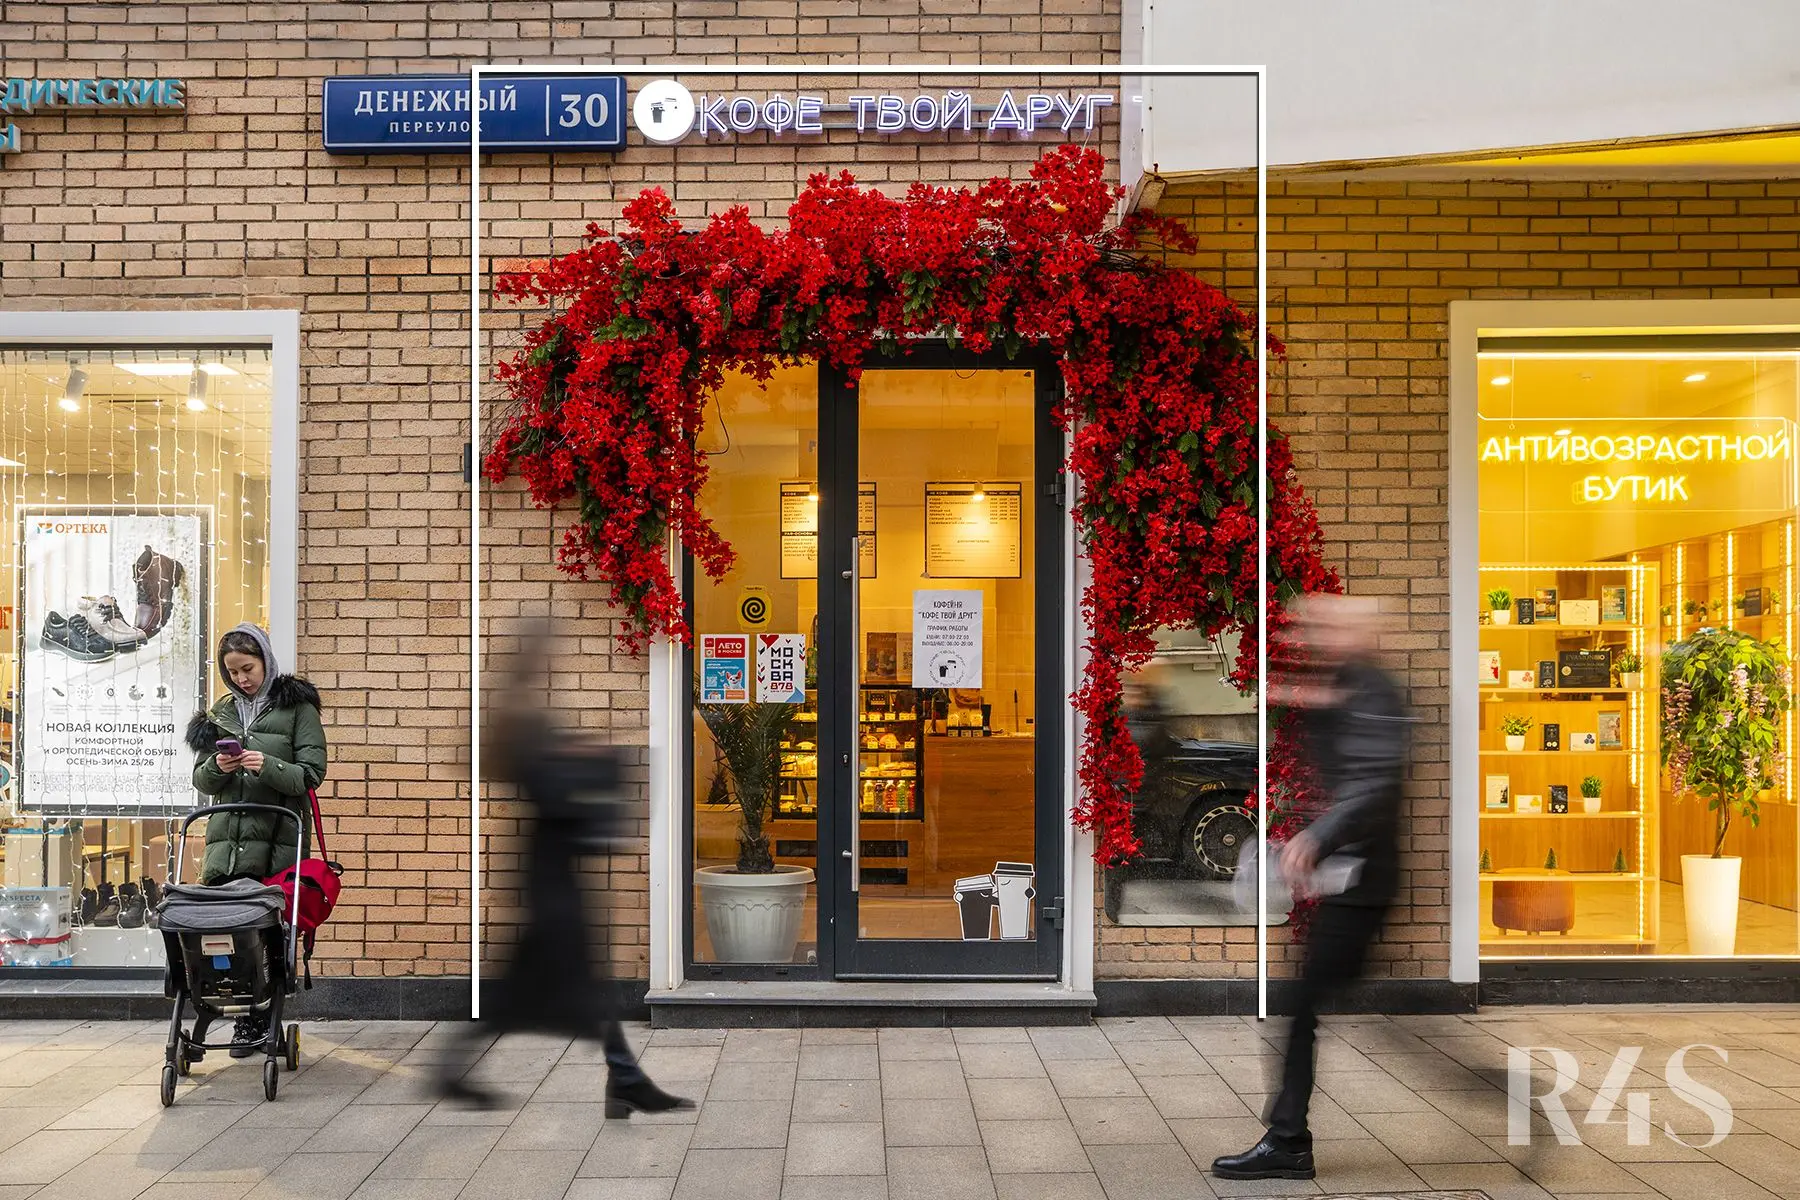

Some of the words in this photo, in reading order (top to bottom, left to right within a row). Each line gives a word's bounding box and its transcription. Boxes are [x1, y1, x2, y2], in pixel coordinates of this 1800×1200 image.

[0, 79, 185, 110] ДИЧЕСКИЕ
[354, 84, 517, 116] ДЕНЕЖНЫЙ
[558, 93, 609, 128] 30
[700, 93, 824, 134] КОФЕ
[849, 90, 970, 133] ТВОЙ
[989, 90, 1113, 132] ДРУГ
[1481, 429, 1791, 462] АНТИВОЗРАСТНОЙ
[1582, 475, 1690, 502] БУТИК
[55, 523, 108, 534] ОРТЕКА
[933, 600, 963, 609] КОФЕЙНЯ
[940, 610, 957, 620] ТВОЙ
[771, 647, 794, 658] МО
[771, 659, 794, 670] СК
[771, 671, 794, 681] ВА
[770, 682, 794, 690] 878
[46, 722, 91, 733] НОВАЯ
[95, 723, 175, 734] КОЛЛЕКЦИЯ
[74, 736, 144, 746] КОМФОРТНОЙ
[52, 746, 142, 756] ОРТОПЕДИЧЕСКОЙ
[144, 748, 177, 756] ОБУВИ
[66, 757, 129, 766] ОСЕНЬ-ЗИМА
[130, 758, 155, 766] 25/26
